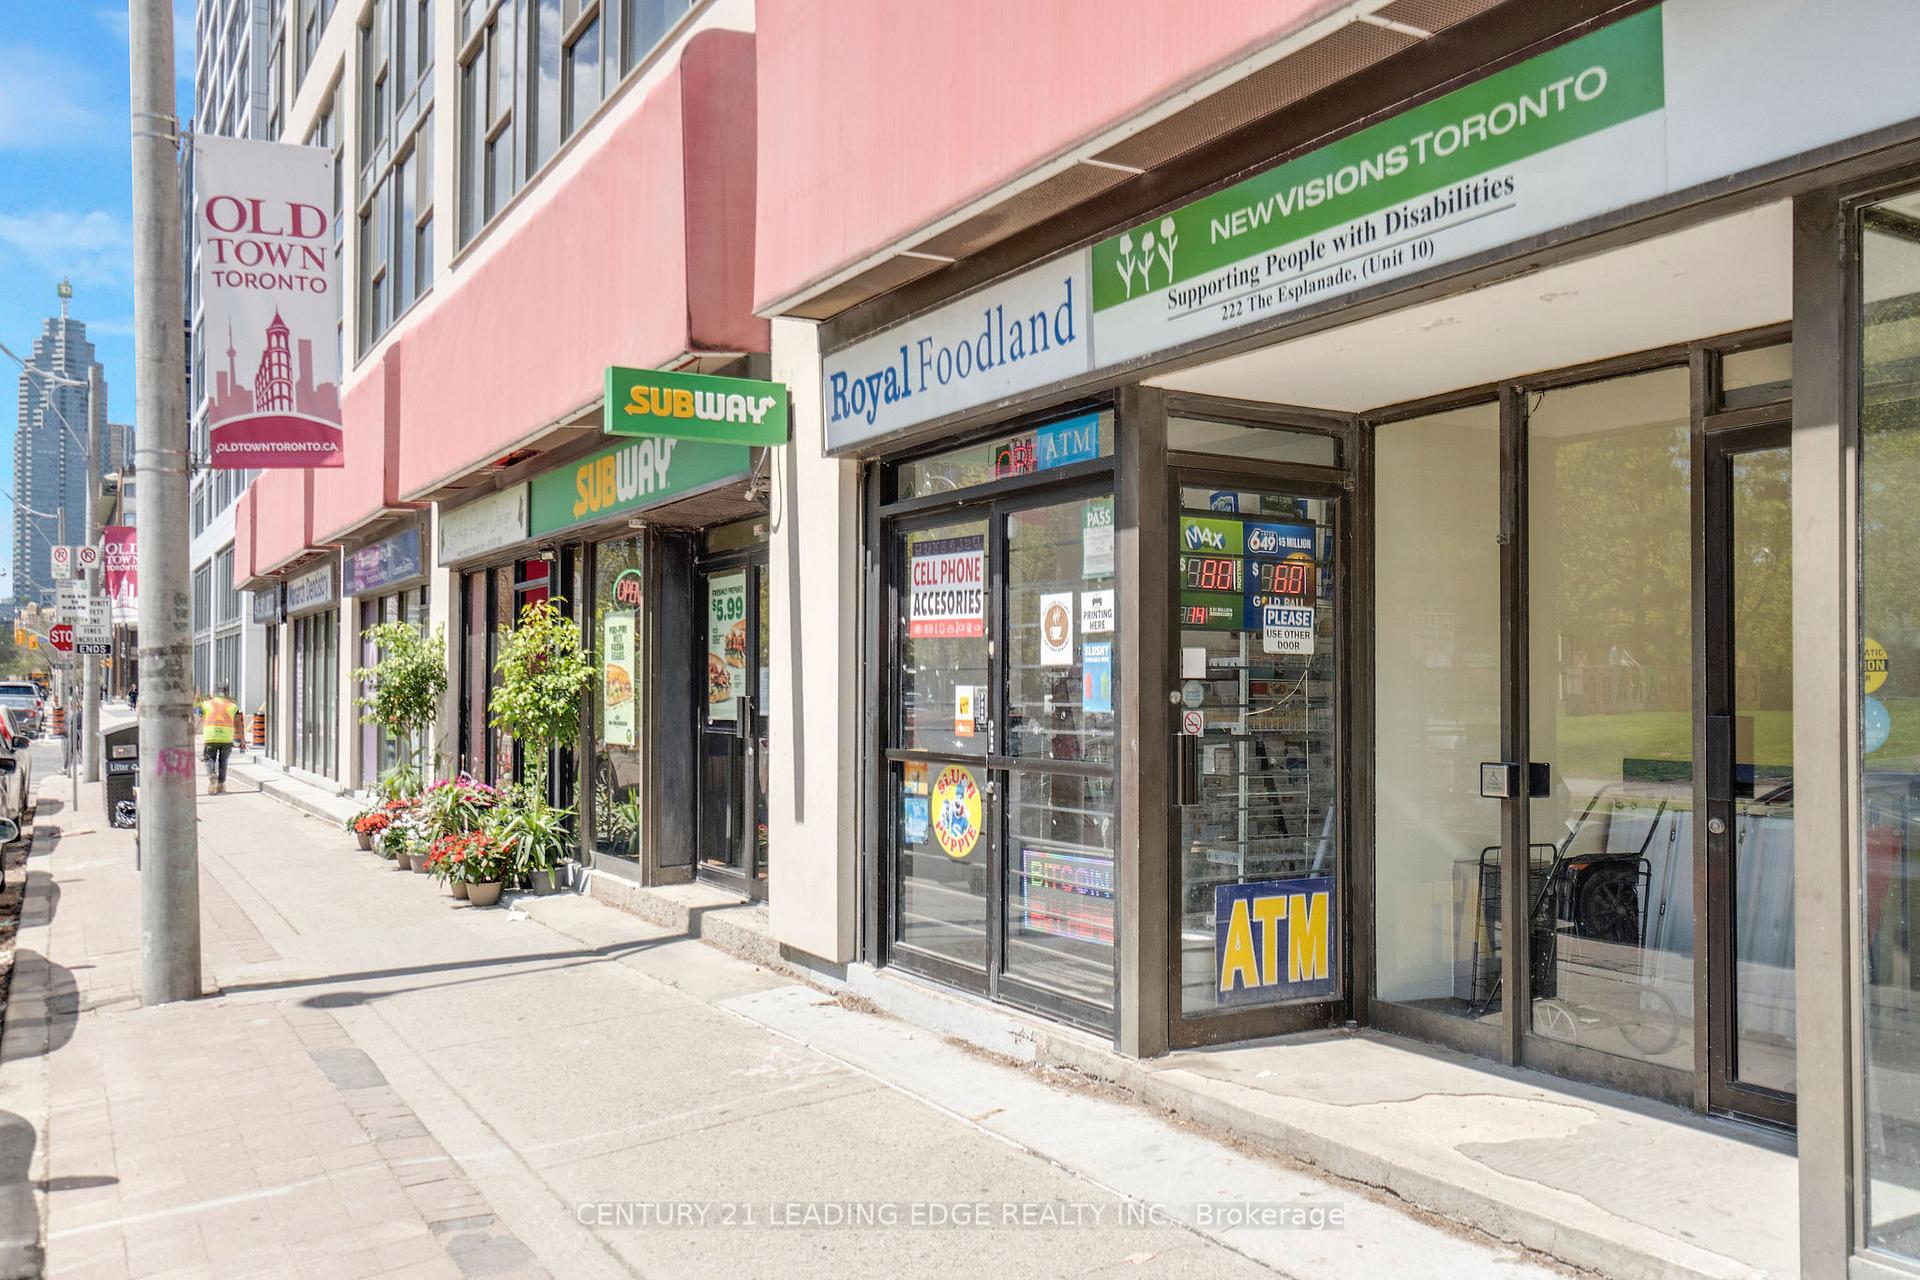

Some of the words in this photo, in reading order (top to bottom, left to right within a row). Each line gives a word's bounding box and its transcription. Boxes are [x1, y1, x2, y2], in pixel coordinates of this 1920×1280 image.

[206, 195, 327, 239] OLD
[1168, 262, 1260, 310] Supporting
[1266, 240, 1326, 275] People
[1333, 221, 1377, 251] with
[1386, 174, 1515, 235] Disabilities
[207, 238, 327, 272] TOWN
[211, 270, 327, 294] TORONTO
[1222, 304, 1243, 322] 222
[1247, 294, 1272, 313] The
[1278, 269, 1357, 304] Esplanade,
[1362, 247, 1403, 280] (Unit
[1411, 238, 1434, 262] 10)
[830, 345, 912, 425] Royal
[917, 276, 1076, 392] Foodland
[625, 385, 776, 425] SUBWAY
[1046, 426, 1091, 460] ATM
[573, 438, 678, 520] SUBWAY
[1087, 509, 1111, 528] PASS
[1185, 526, 1223, 550] MAX
[1286, 537, 1312, 550] MILLION
[913, 561, 938, 587] CELL
[940, 557, 981, 584] PHONE
[712, 596, 744, 622] $5.99
[913, 589, 982, 616] ACCESORIES
[1083, 608, 1113, 620] PRINTING
[1089, 620, 1106, 631] HERE
[1267, 609, 1310, 627] PLEASE
[51, 631, 73, 644] STO
[1266, 629, 1283, 639] USE
[1284, 630, 1311, 640] OTHER
[1277, 641, 1300, 651] DOOR
[79, 645, 107, 654] ENDS
[1084, 645, 1109, 657] SLUSHY
[110, 763, 129, 772] Litter
[1219, 891, 1330, 992] ATM
